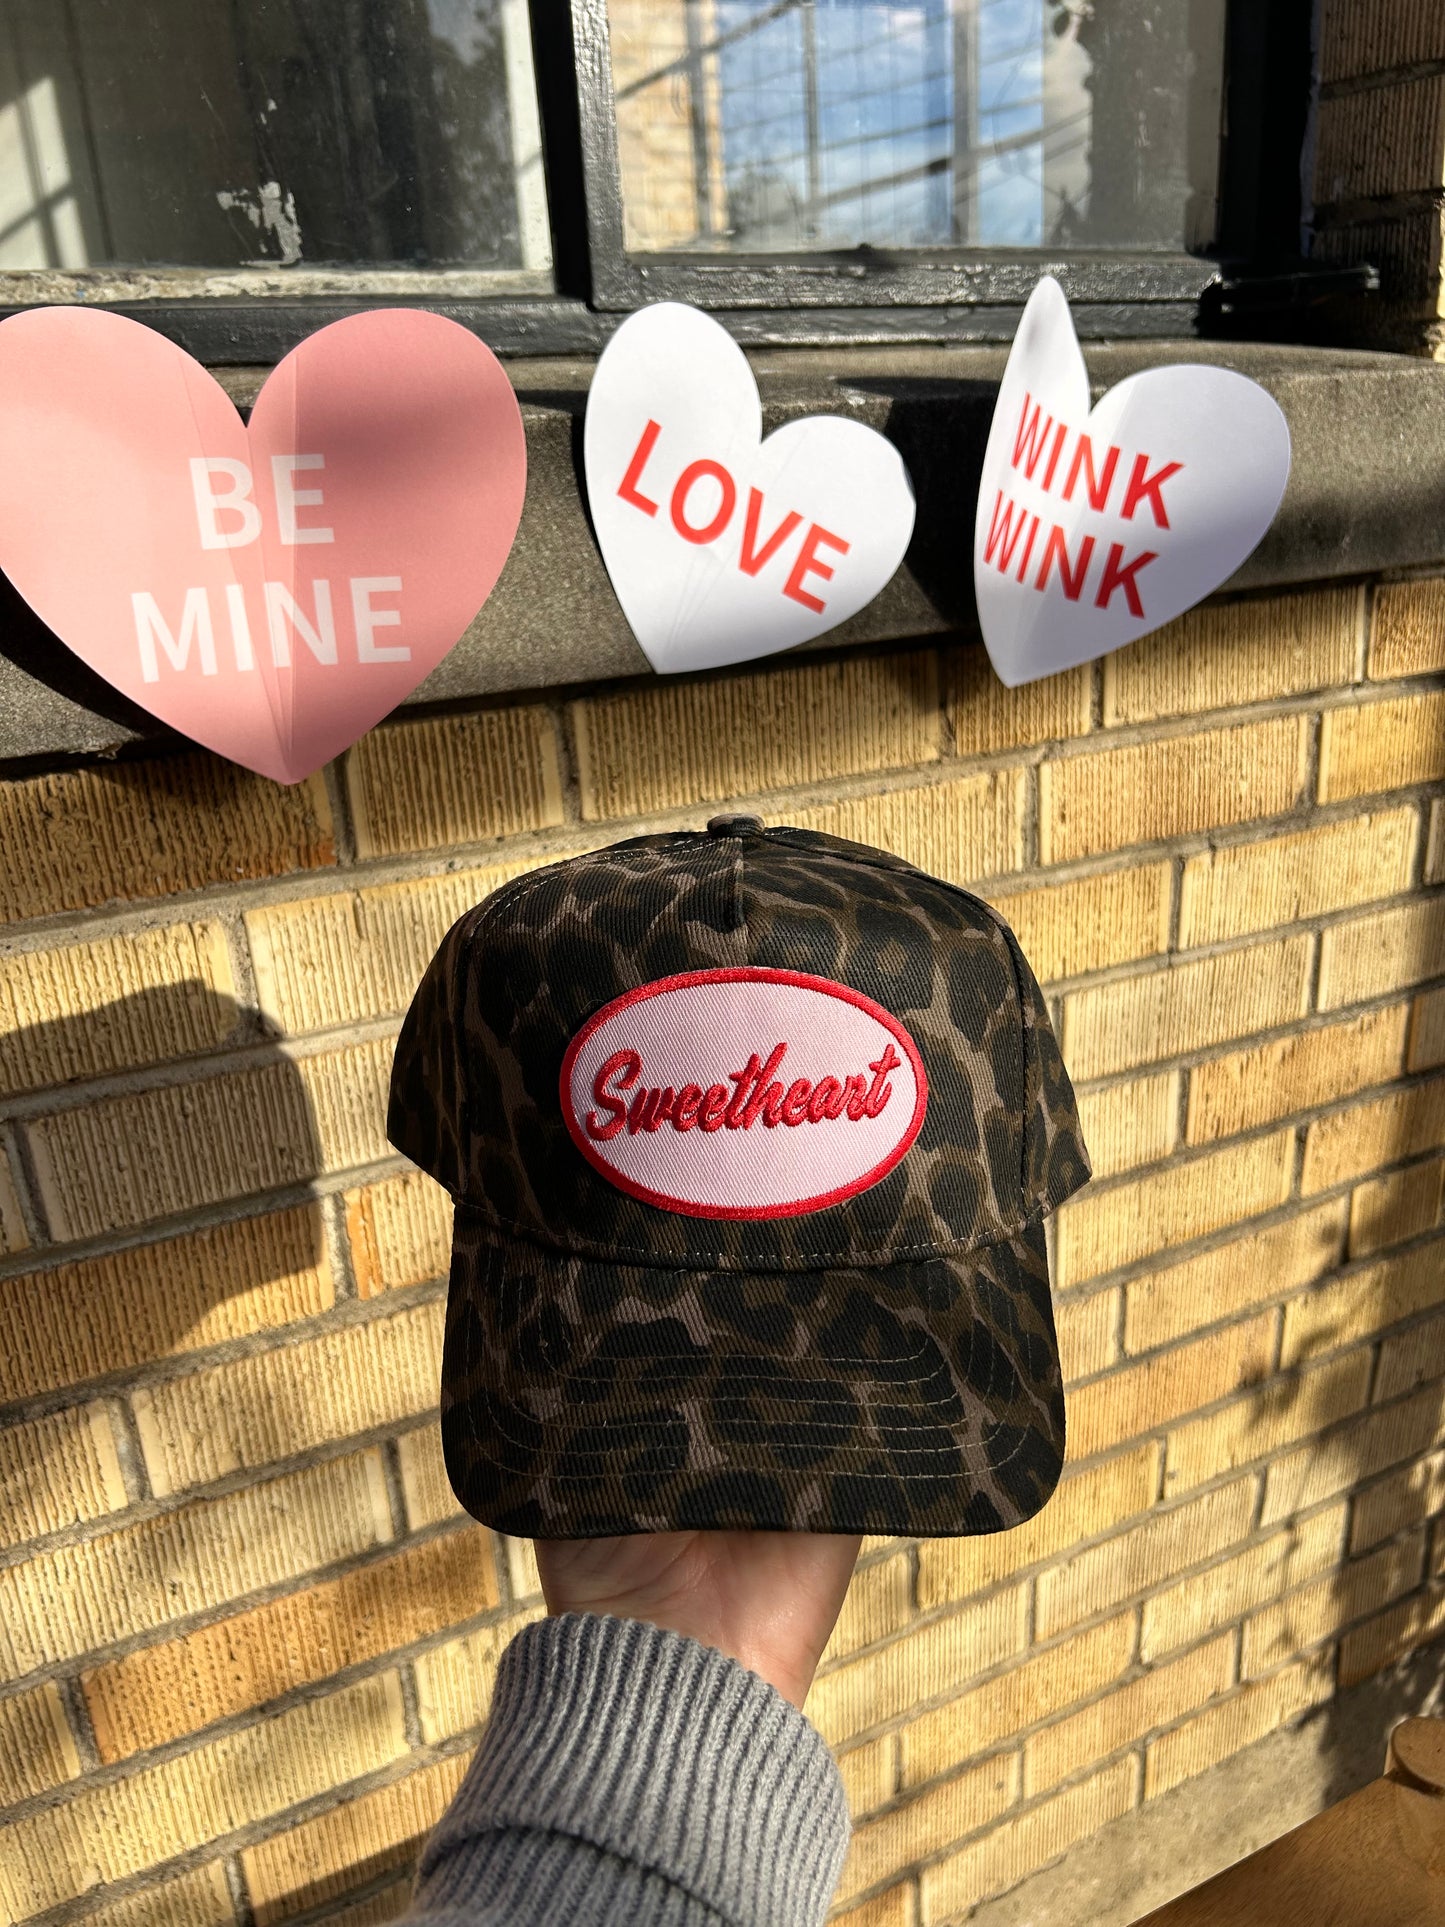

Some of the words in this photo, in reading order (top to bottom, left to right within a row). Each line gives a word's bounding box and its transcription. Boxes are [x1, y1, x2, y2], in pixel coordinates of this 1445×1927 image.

[189, 453, 336, 551] BE
[617, 418, 850, 614] LOVE
[1011, 391, 1186, 530] WINK
[983, 489, 1160, 620] WINK
[131, 576, 412, 684] MINE
[585, 1042, 902, 1142] Sweetheart
